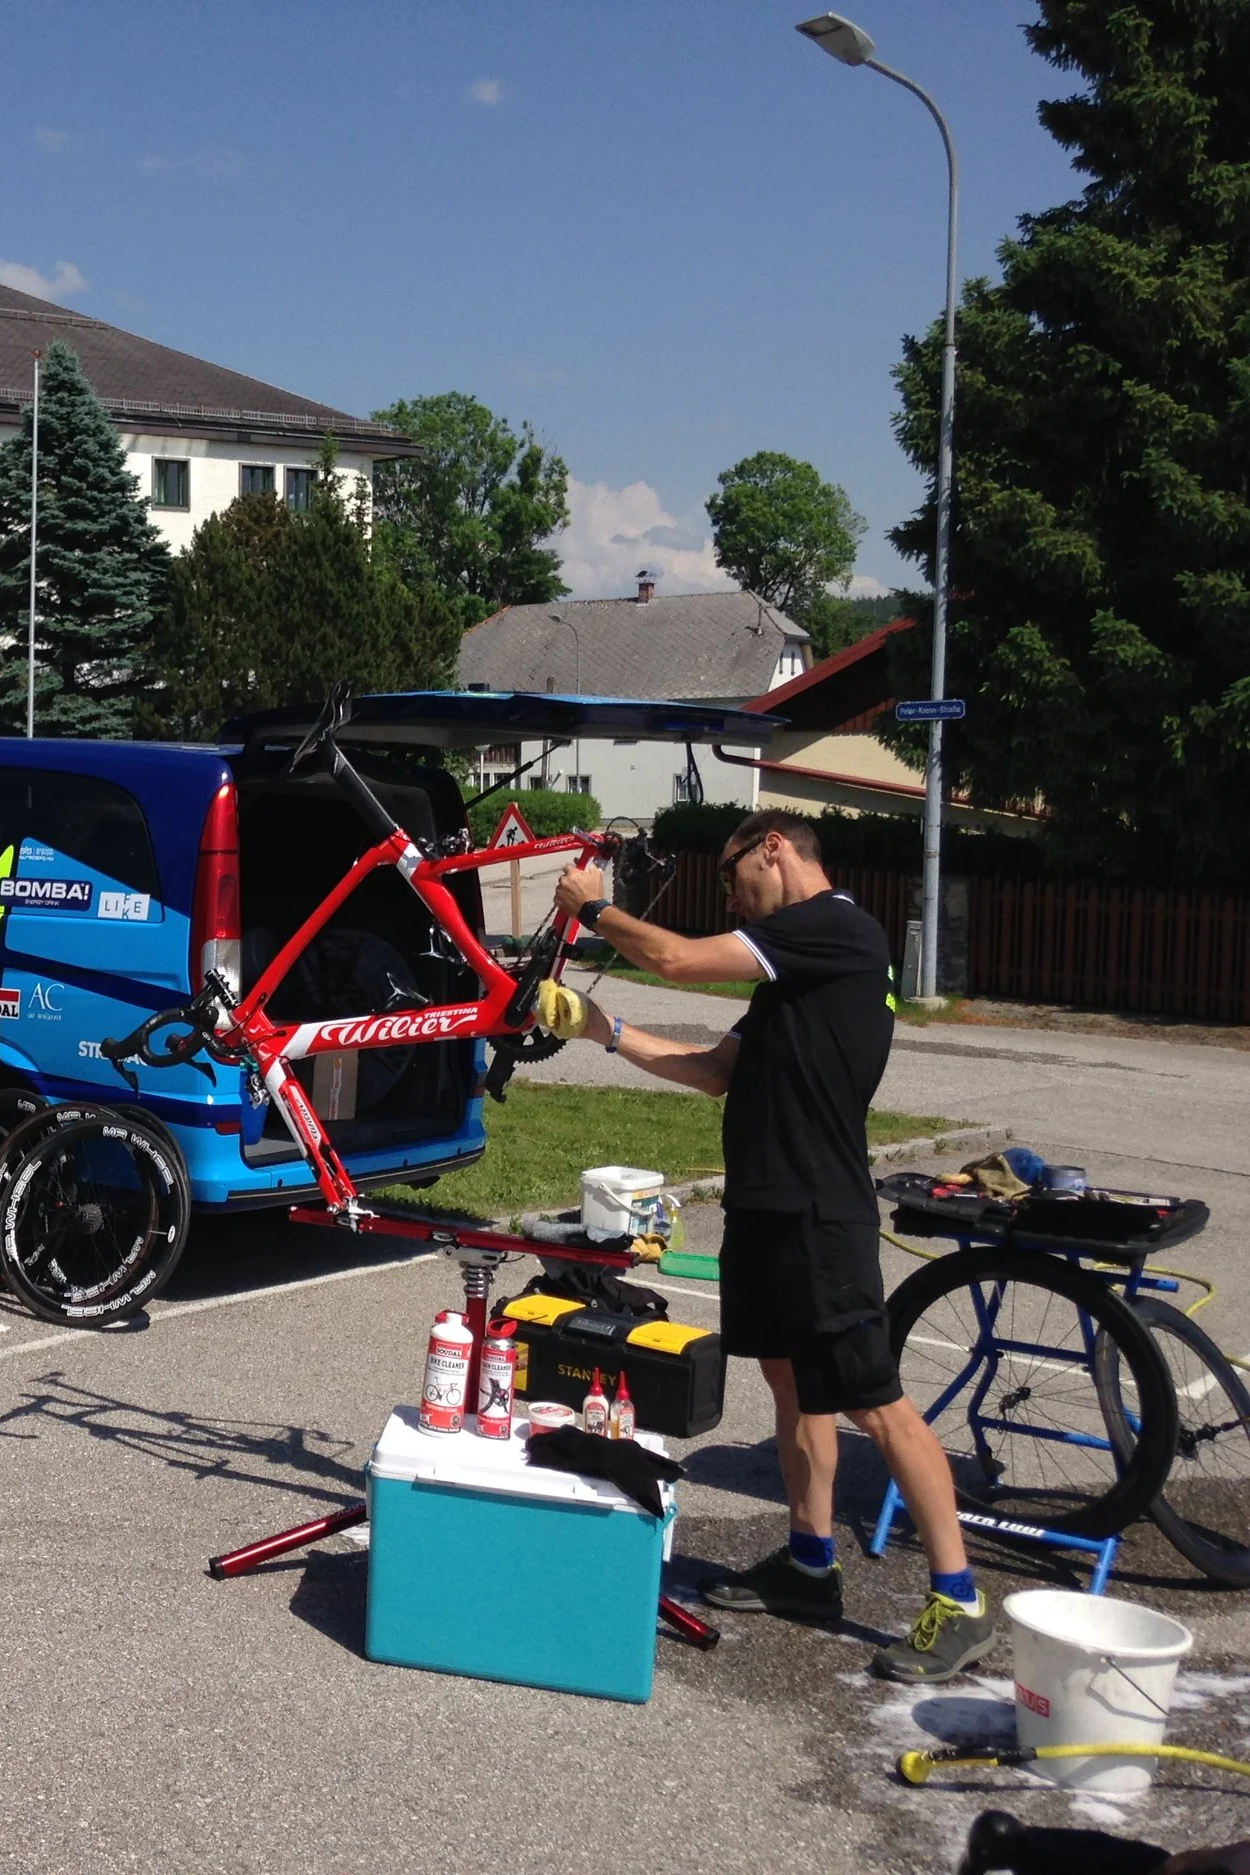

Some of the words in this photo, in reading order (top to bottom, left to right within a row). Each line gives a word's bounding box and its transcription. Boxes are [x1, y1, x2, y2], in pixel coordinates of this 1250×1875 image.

[0, 880, 90, 900] BOMBA!
[28, 982, 65, 1012] AC
[424, 1007, 479, 1020] TRIESTINA
[321, 1014, 478, 1046] Wilier
[130, 1132, 174, 1195] WHEEL
[4, 1160, 43, 1231] WHEEL
[60, 1295, 132, 1318] WHEEL
[437, 1347, 461, 1358] SOUDAL
[441, 1360, 465, 1371] CLEANER
[557, 1364, 617, 1387] STANEY
